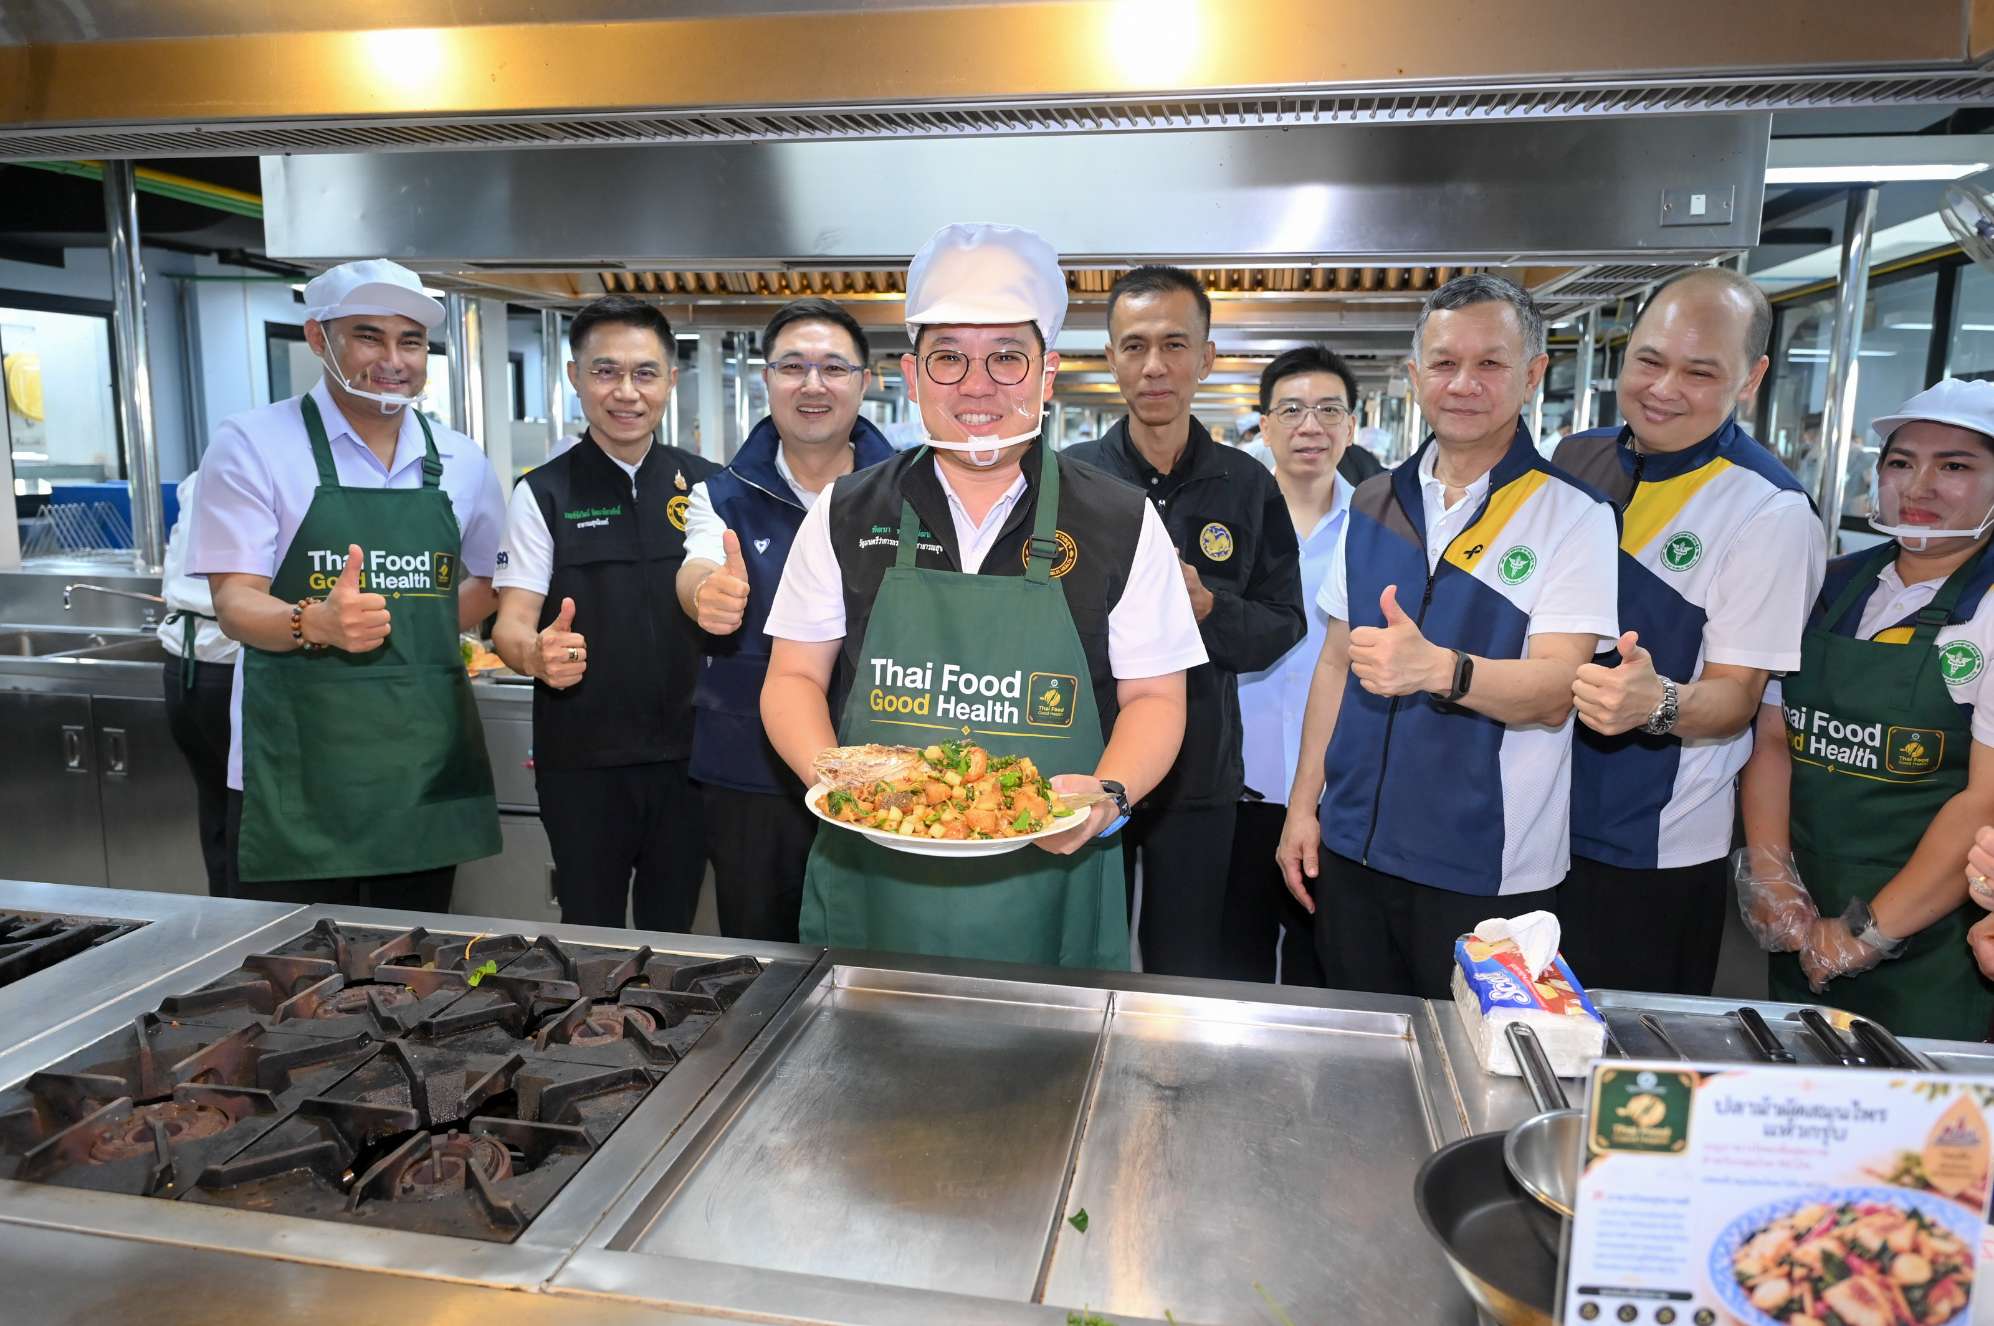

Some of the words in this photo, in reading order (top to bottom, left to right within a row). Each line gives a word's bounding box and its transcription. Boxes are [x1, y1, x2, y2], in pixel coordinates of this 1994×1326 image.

[370, 550, 430, 571] Food
[370, 572, 431, 589] Health
[870, 658, 934, 690] Thai
[941, 663, 1022, 699] Food
[870, 688, 931, 716] Good
[936, 694, 1019, 725] Health
[1812, 710, 1882, 748] Food
[1810, 735, 1878, 770] Health
